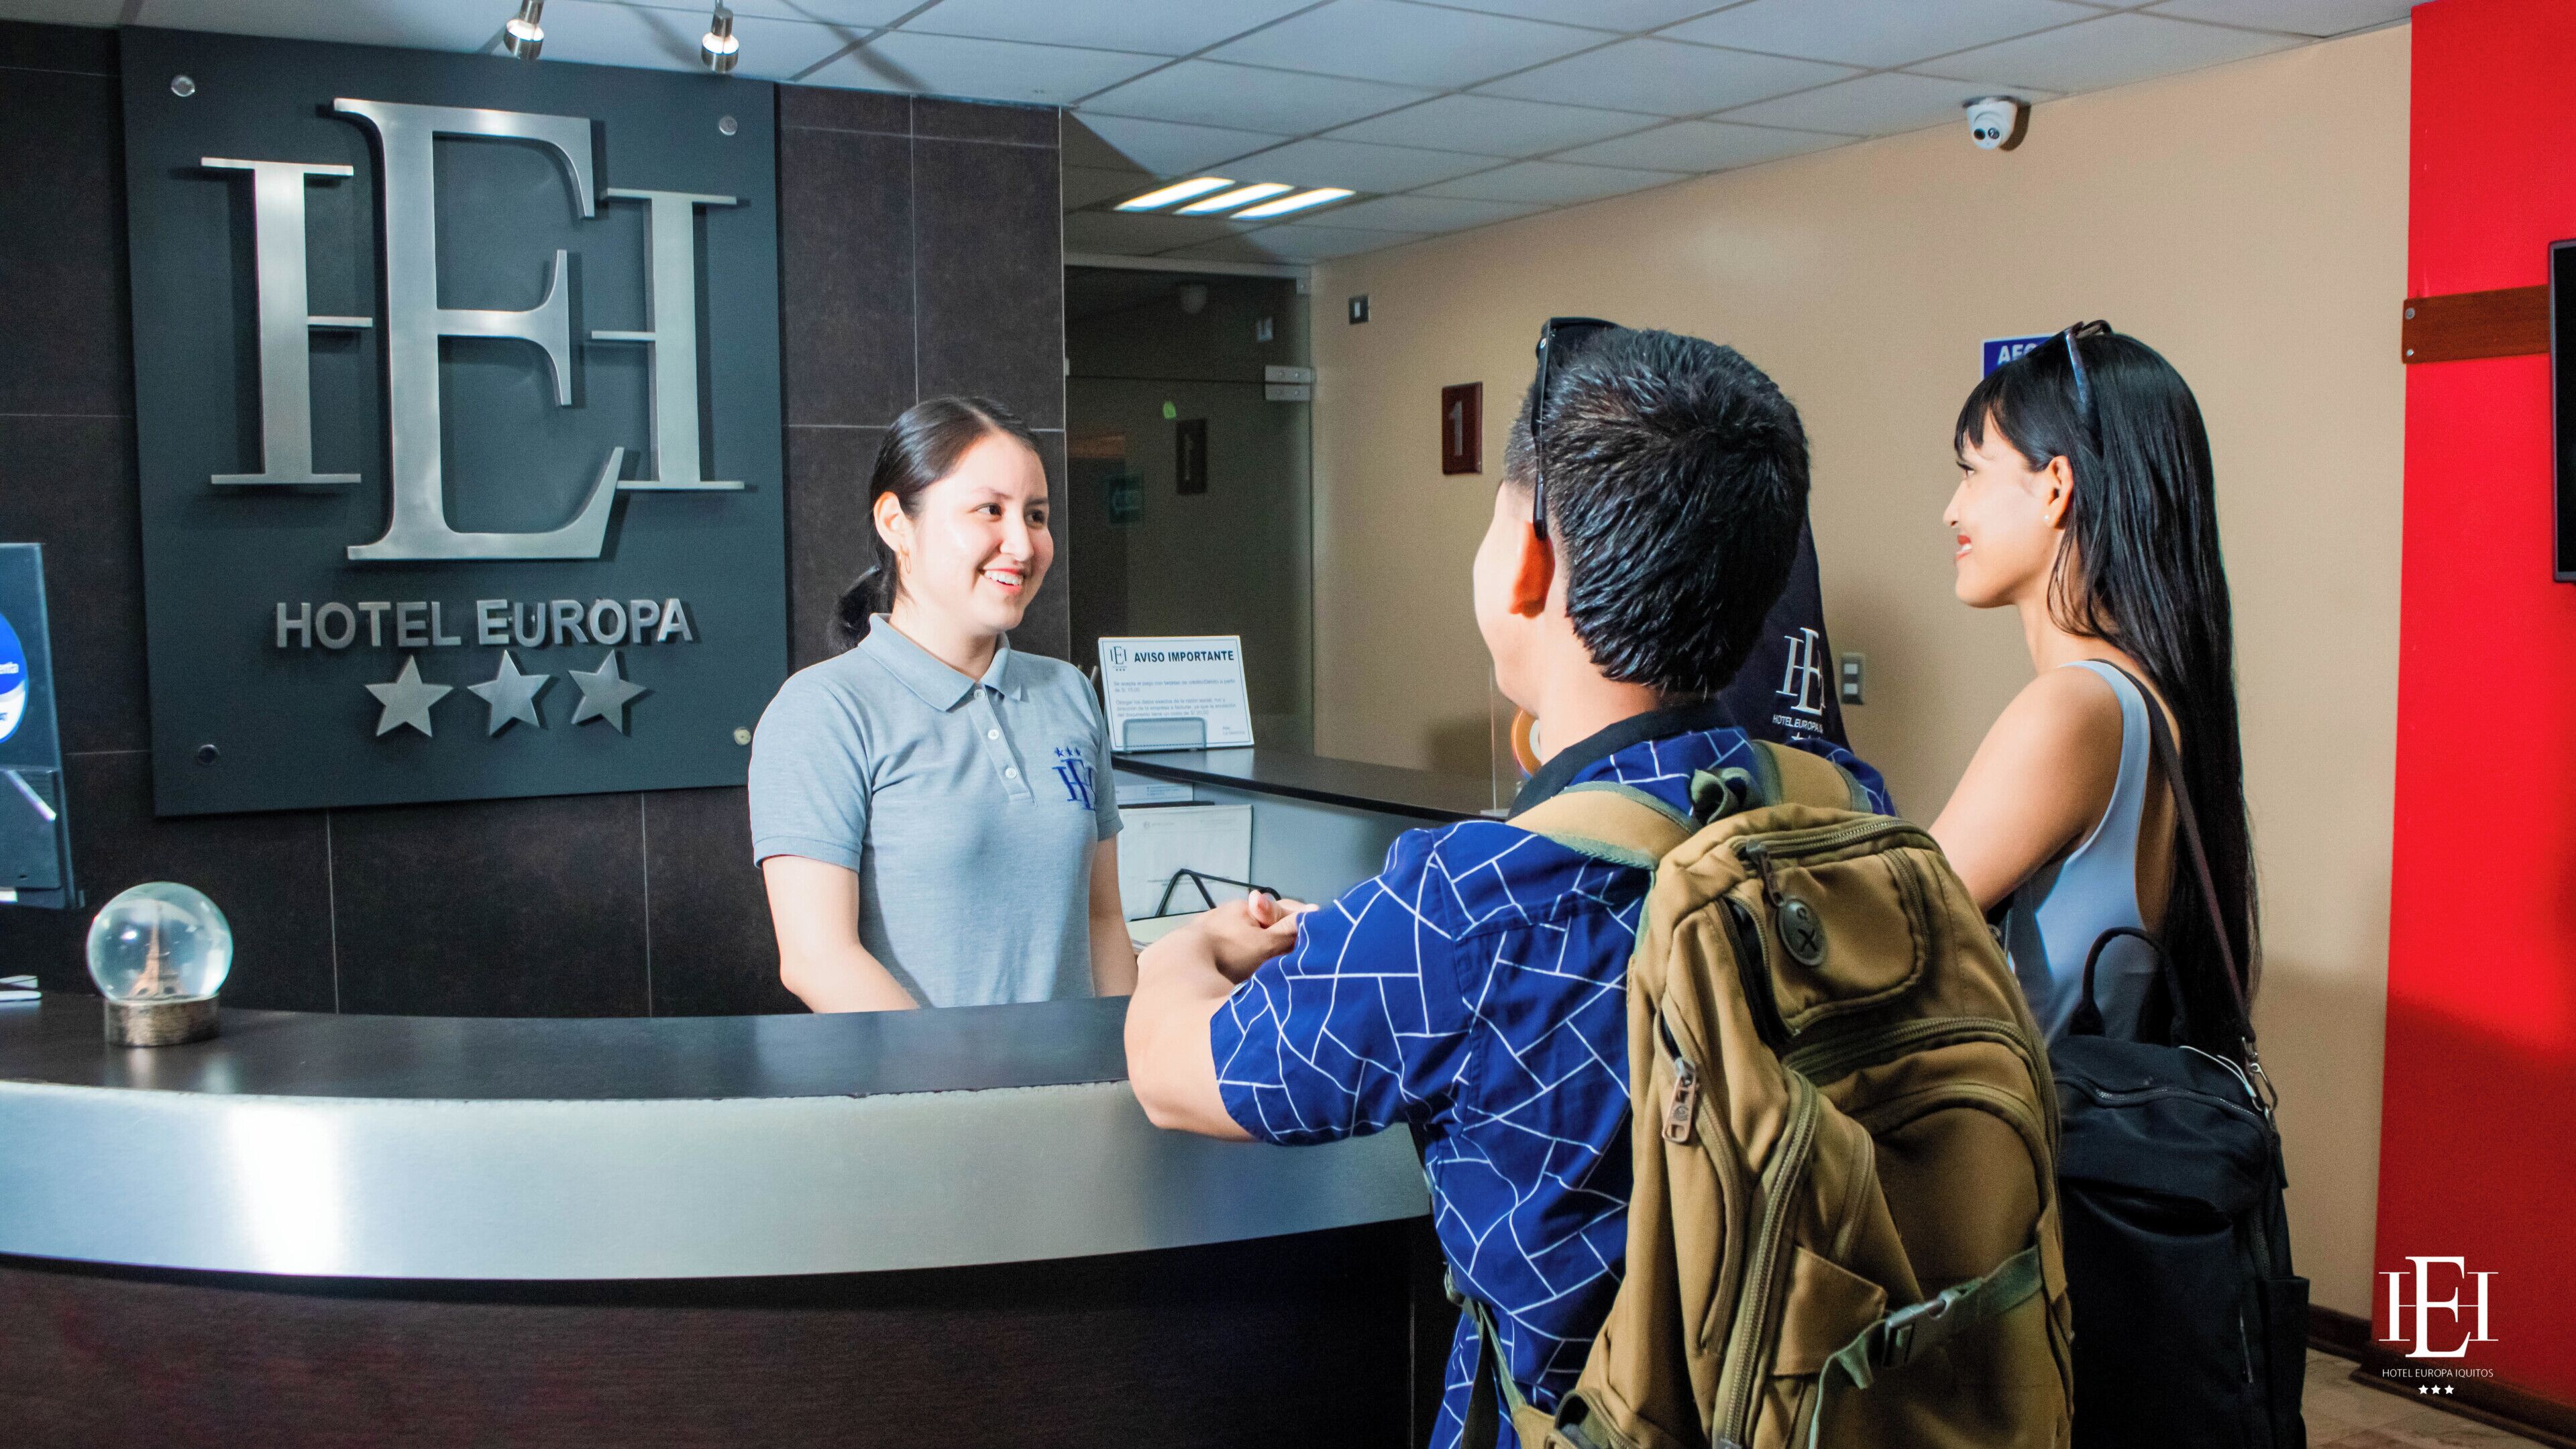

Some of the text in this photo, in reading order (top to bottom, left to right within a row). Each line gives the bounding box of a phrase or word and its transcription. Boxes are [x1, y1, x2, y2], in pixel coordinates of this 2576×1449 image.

[1448, 401, 1462, 456] 1
[276, 598, 693, 648] HOTEL EUROPA
[1134, 650, 1234, 663] AVISO IMPORTANTE
[1772, 714, 1793, 727] HOTEL
